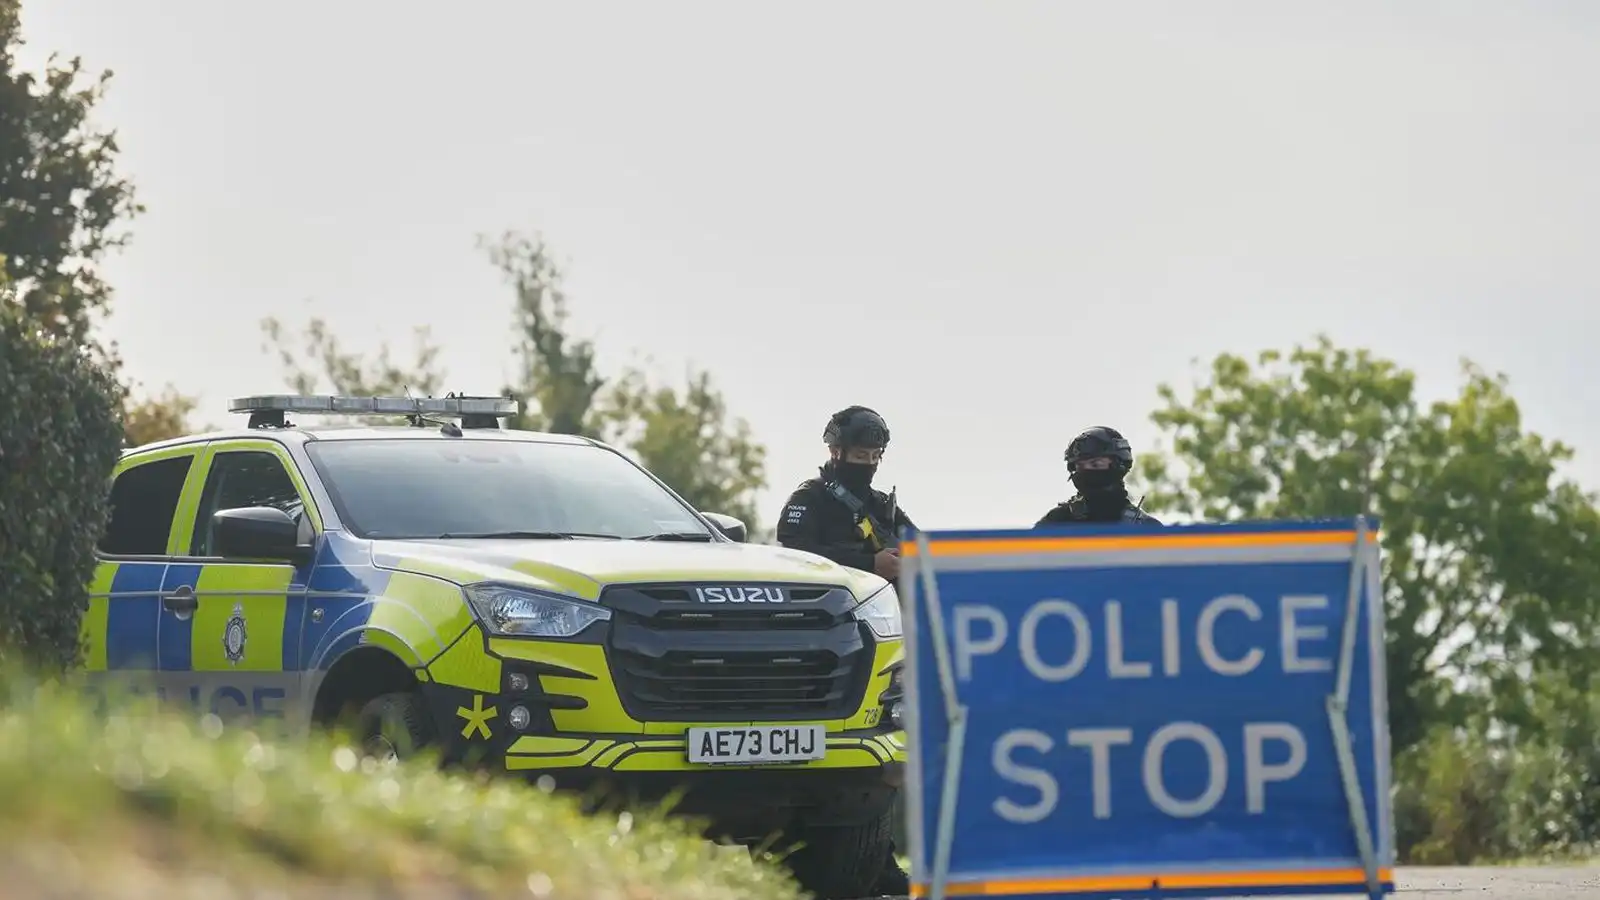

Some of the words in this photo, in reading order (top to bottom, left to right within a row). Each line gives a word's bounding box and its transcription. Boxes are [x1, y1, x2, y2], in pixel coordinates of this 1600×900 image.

[695, 587, 785, 603] ISUZU
[952, 594, 1333, 682] POLICE
[700, 729, 762, 756] AE73
[769, 728, 815, 755] CHJ
[992, 721, 1308, 825] STOP
